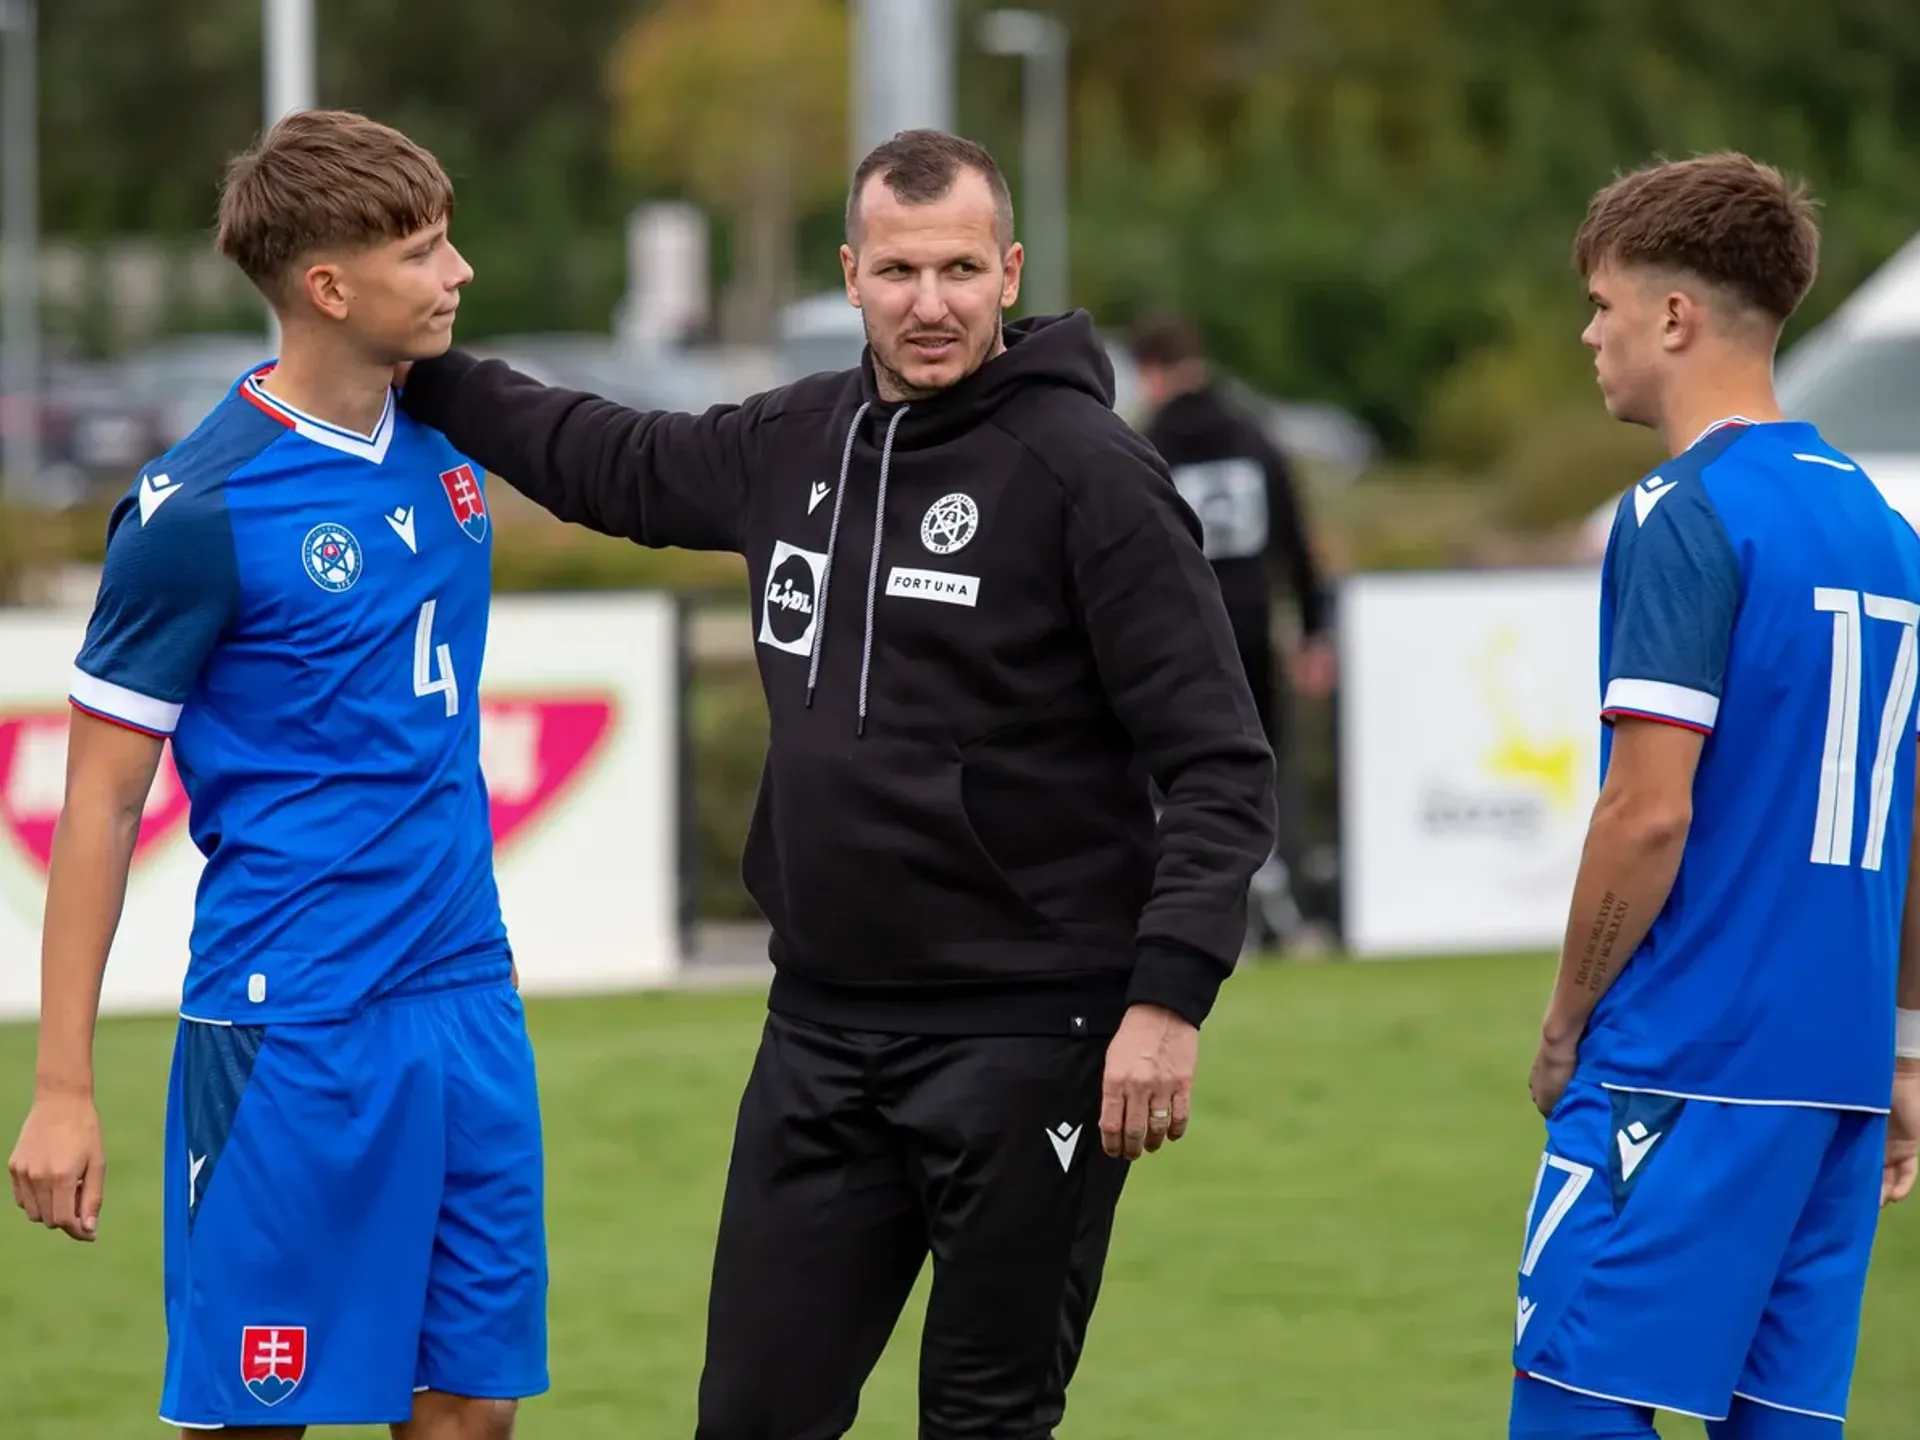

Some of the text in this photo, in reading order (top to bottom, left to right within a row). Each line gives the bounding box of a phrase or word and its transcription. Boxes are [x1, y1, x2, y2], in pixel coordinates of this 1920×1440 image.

[894, 576, 967, 596] FORTUNA
[414, 599, 459, 717] 4
[1810, 587, 1920, 871] 17
